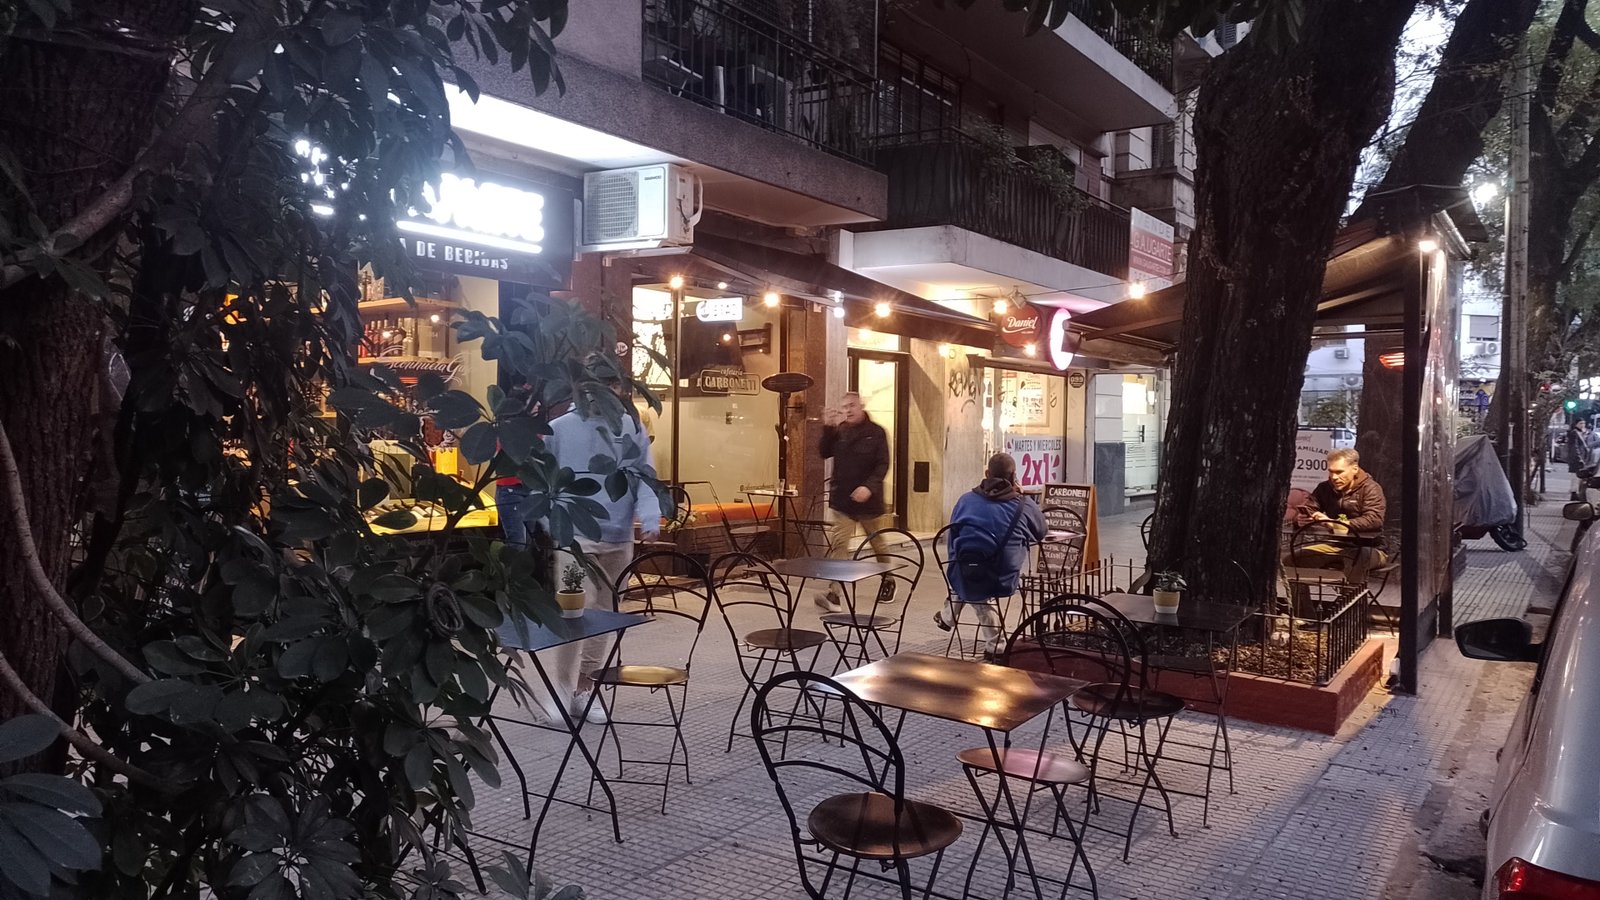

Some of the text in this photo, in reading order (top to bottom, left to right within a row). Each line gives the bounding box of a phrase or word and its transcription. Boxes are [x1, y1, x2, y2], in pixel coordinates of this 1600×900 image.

[416, 240, 436, 259] DE
[1007, 316, 1039, 330] Daniel
[1014, 439, 1033, 452] MARTES
[1297, 445, 1329, 456] AMILIAR
[1021, 453, 1050, 486] 2x1
[1296, 458, 1328, 471] 2900
